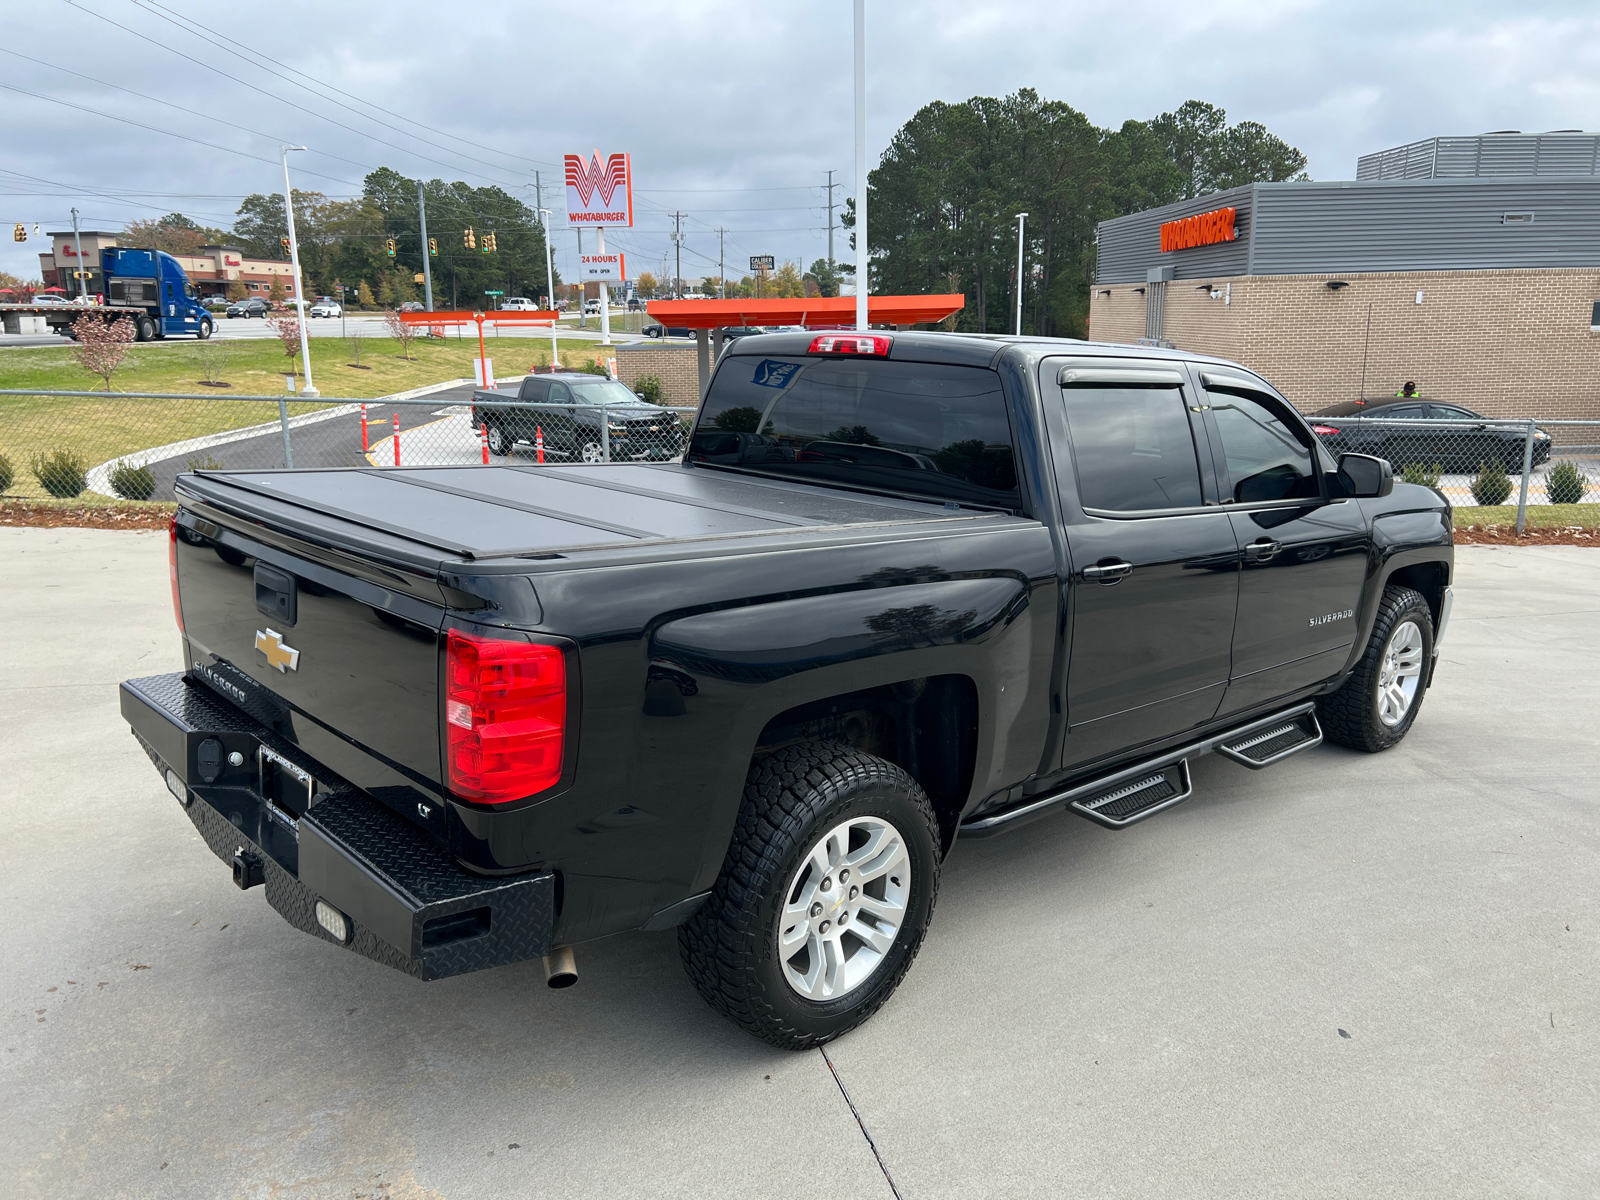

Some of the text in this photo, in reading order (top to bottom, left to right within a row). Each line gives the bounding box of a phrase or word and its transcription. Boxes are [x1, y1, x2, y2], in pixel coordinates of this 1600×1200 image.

[568, 212, 626, 222] WHATABURGER
[1161, 207, 1236, 253] WHATABURGER
[581, 255, 618, 263] 24 HOURS
[1309, 609, 1353, 627] SILVERADO
[195, 660, 247, 703] SILVERADO
[417, 802, 432, 820] LT
